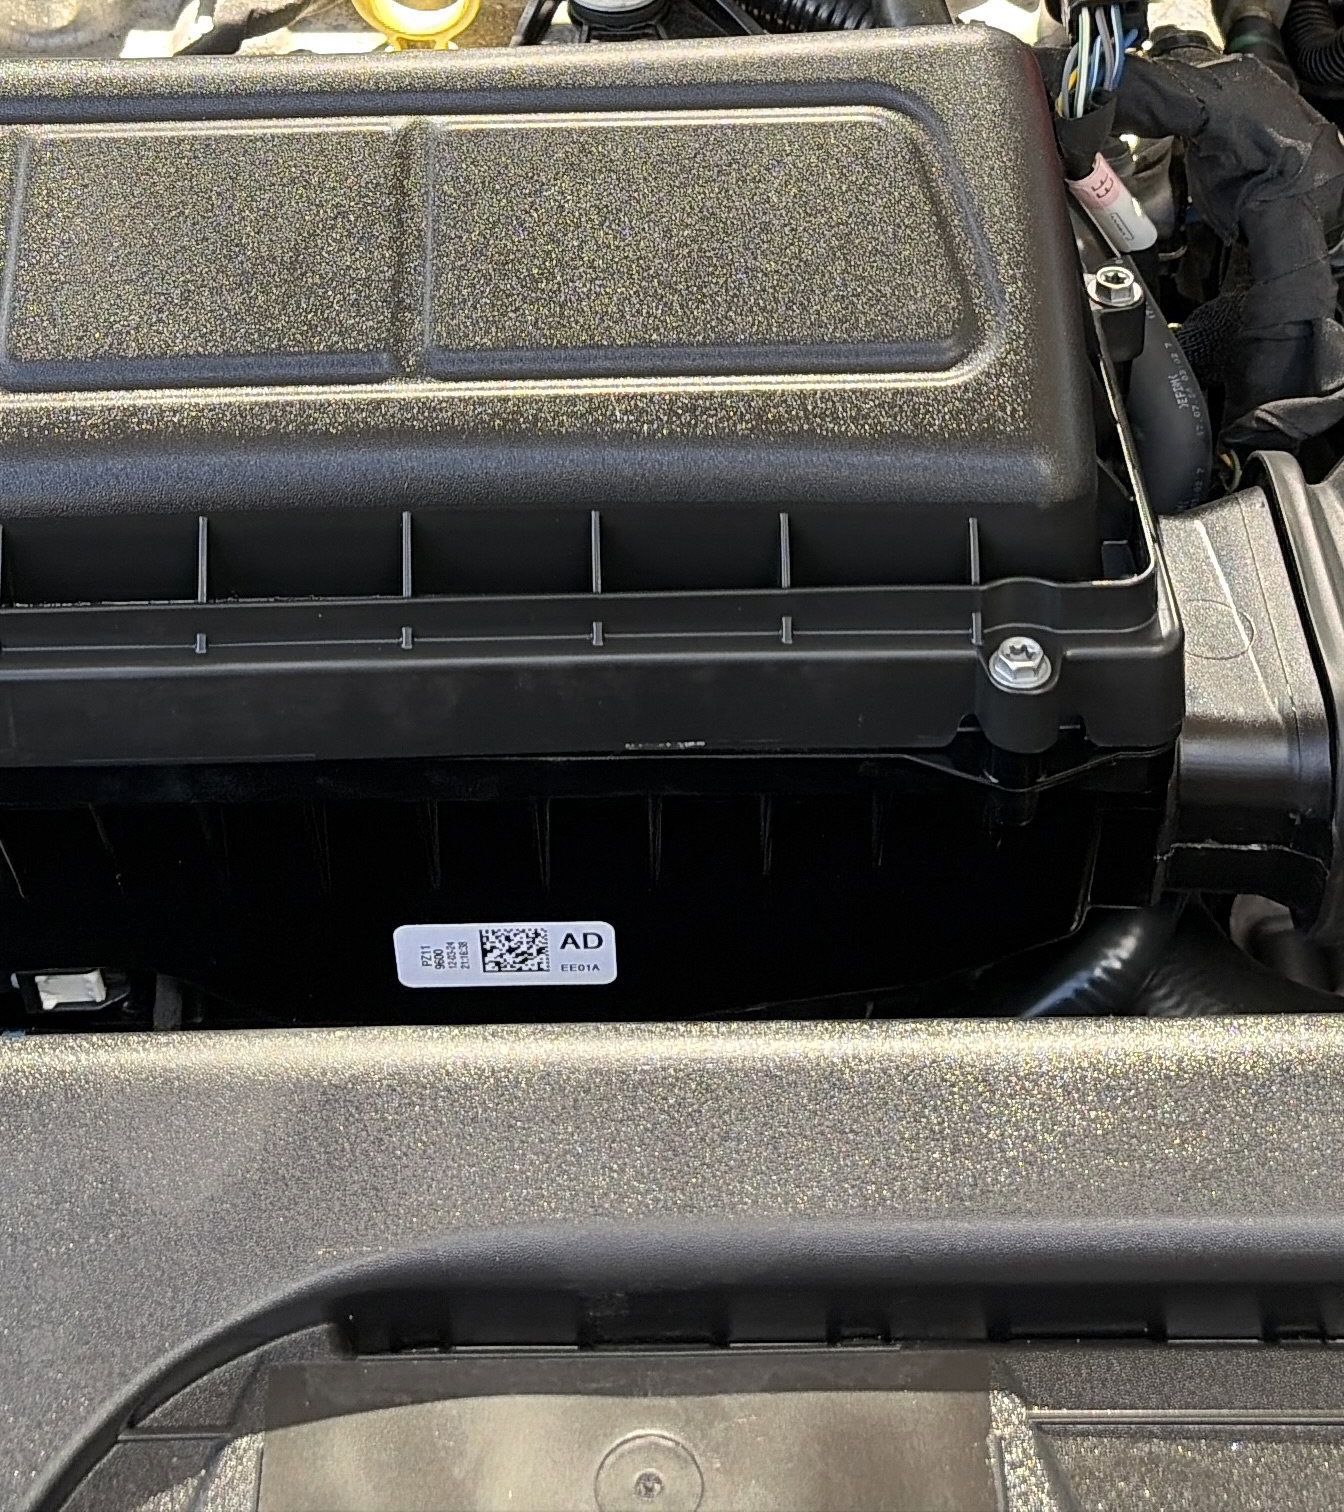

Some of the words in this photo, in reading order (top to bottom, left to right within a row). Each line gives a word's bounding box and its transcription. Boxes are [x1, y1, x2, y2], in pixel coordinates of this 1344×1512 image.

[559, 931, 603, 950] AD
[420, 945, 432, 966] PZ11
[432, 948, 445, 969] 9600
[560, 963, 600, 972] EE01A
